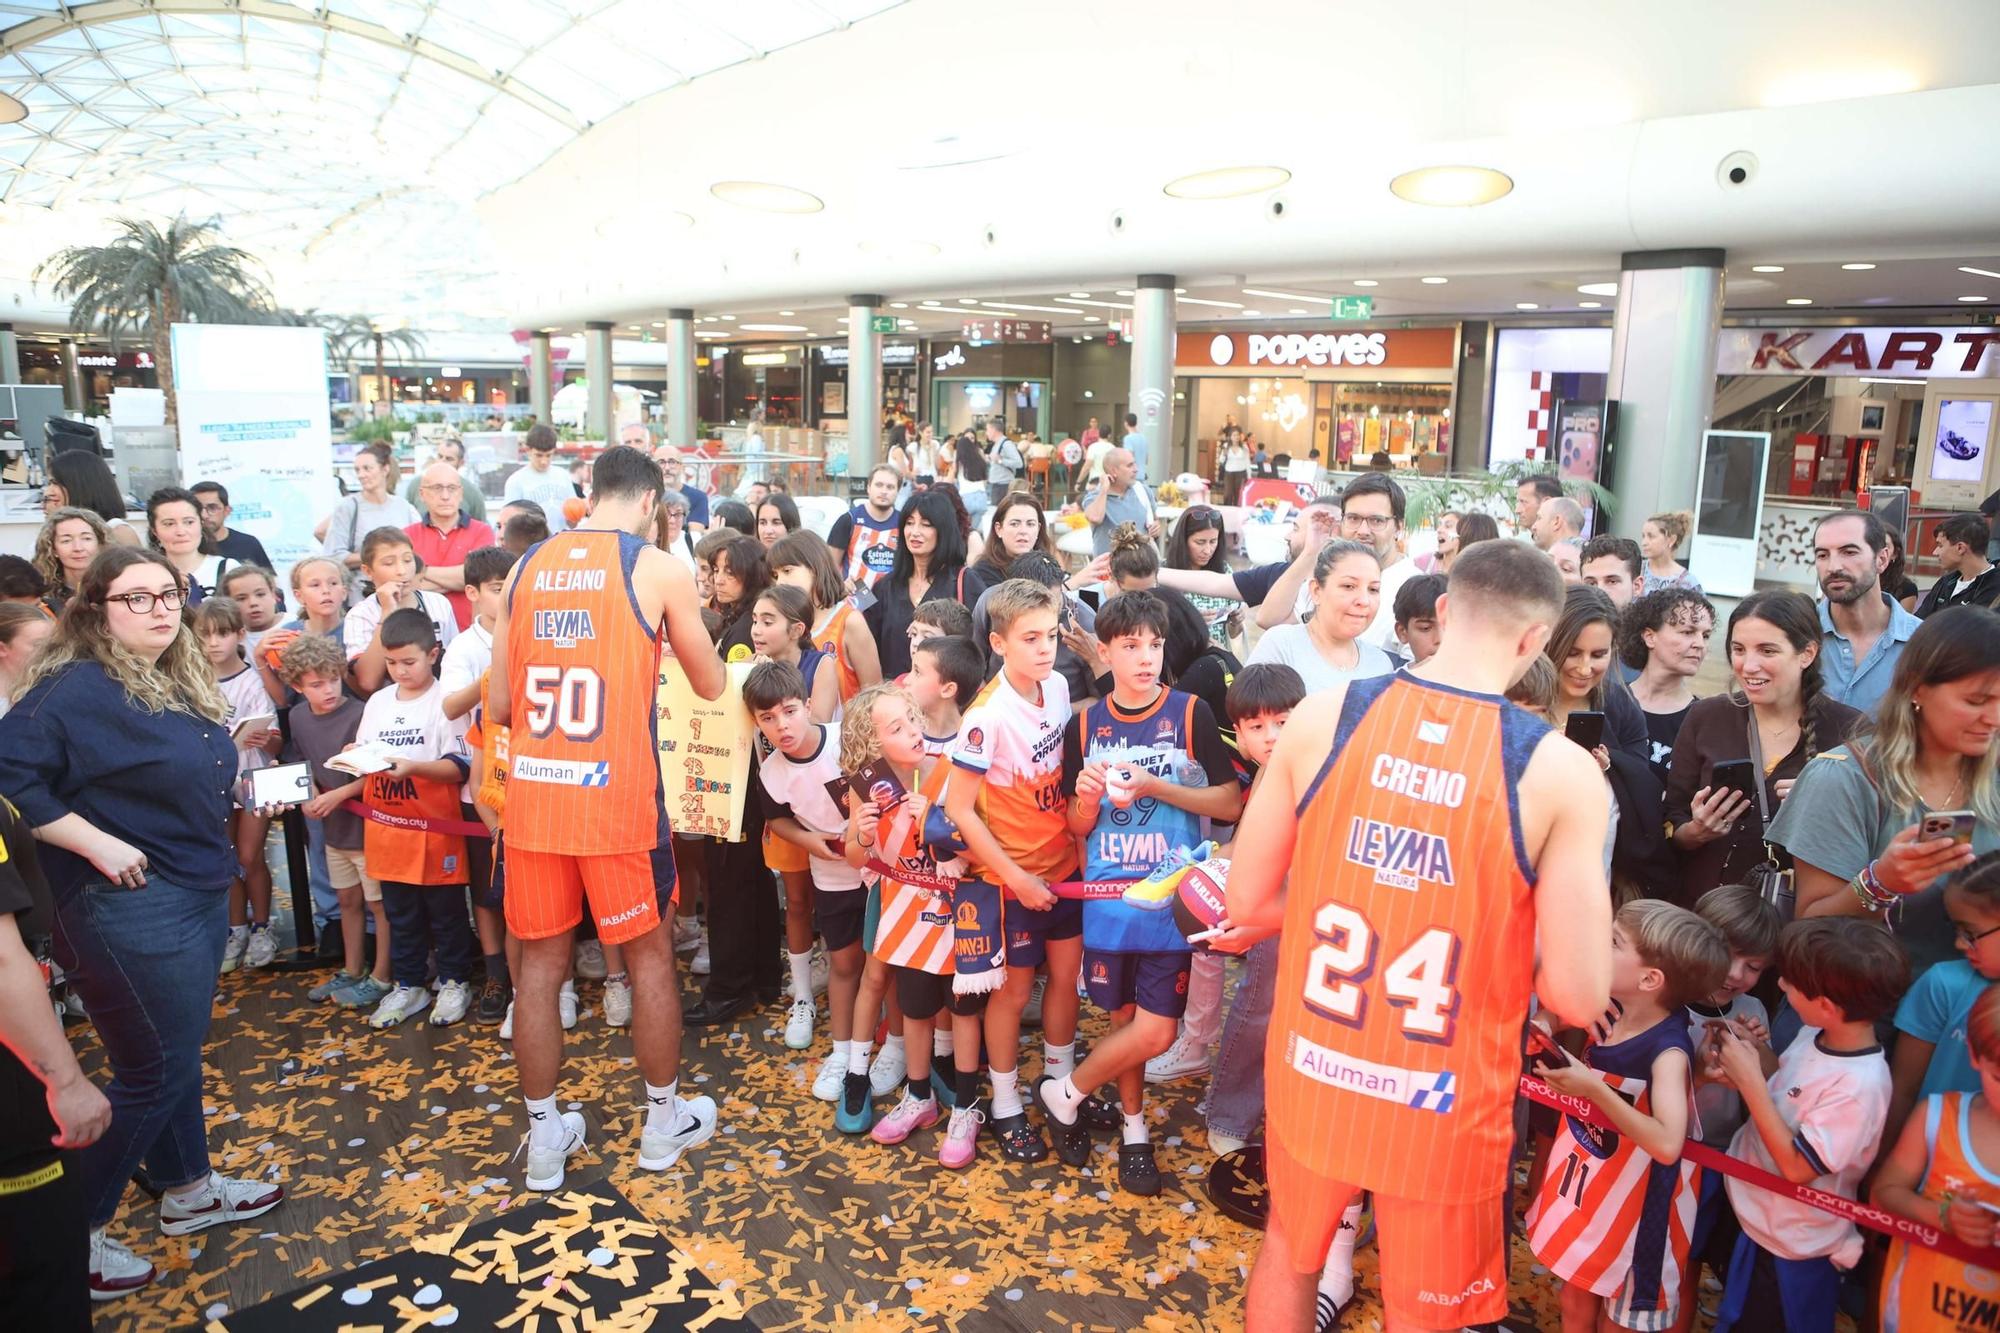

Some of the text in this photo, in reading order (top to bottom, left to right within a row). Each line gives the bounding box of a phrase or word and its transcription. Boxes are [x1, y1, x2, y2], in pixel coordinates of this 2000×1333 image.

[1005, 324, 1012, 335] 2
[1752, 332, 2000, 371] KART
[1562, 416, 1599, 432] PRO
[534, 569, 606, 591] ALEJANO
[534, 610, 595, 640] LEYMA
[525, 664, 605, 743] 50
[379, 728, 421, 737] BASQUET
[517, 761, 574, 779] Aluman
[1371, 753, 1467, 808] CREMO
[679, 793, 705, 813] 21
[409, 819, 428, 830] city
[1100, 832, 1169, 863] LEYMA
[1346, 818, 1454, 884] LEYMA
[1122, 864, 1150, 872] NATURA
[1377, 872, 1417, 889] NATURA
[936, 874, 956, 890] city
[1188, 875, 1226, 916] HARLEM
[1303, 900, 1462, 1047] 24
[1302, 1051, 1398, 1094] Aluman
[1560, 1094, 1591, 1117] city
[1558, 1151, 1590, 1209] 11
[1797, 1185, 1939, 1246] marineda city
